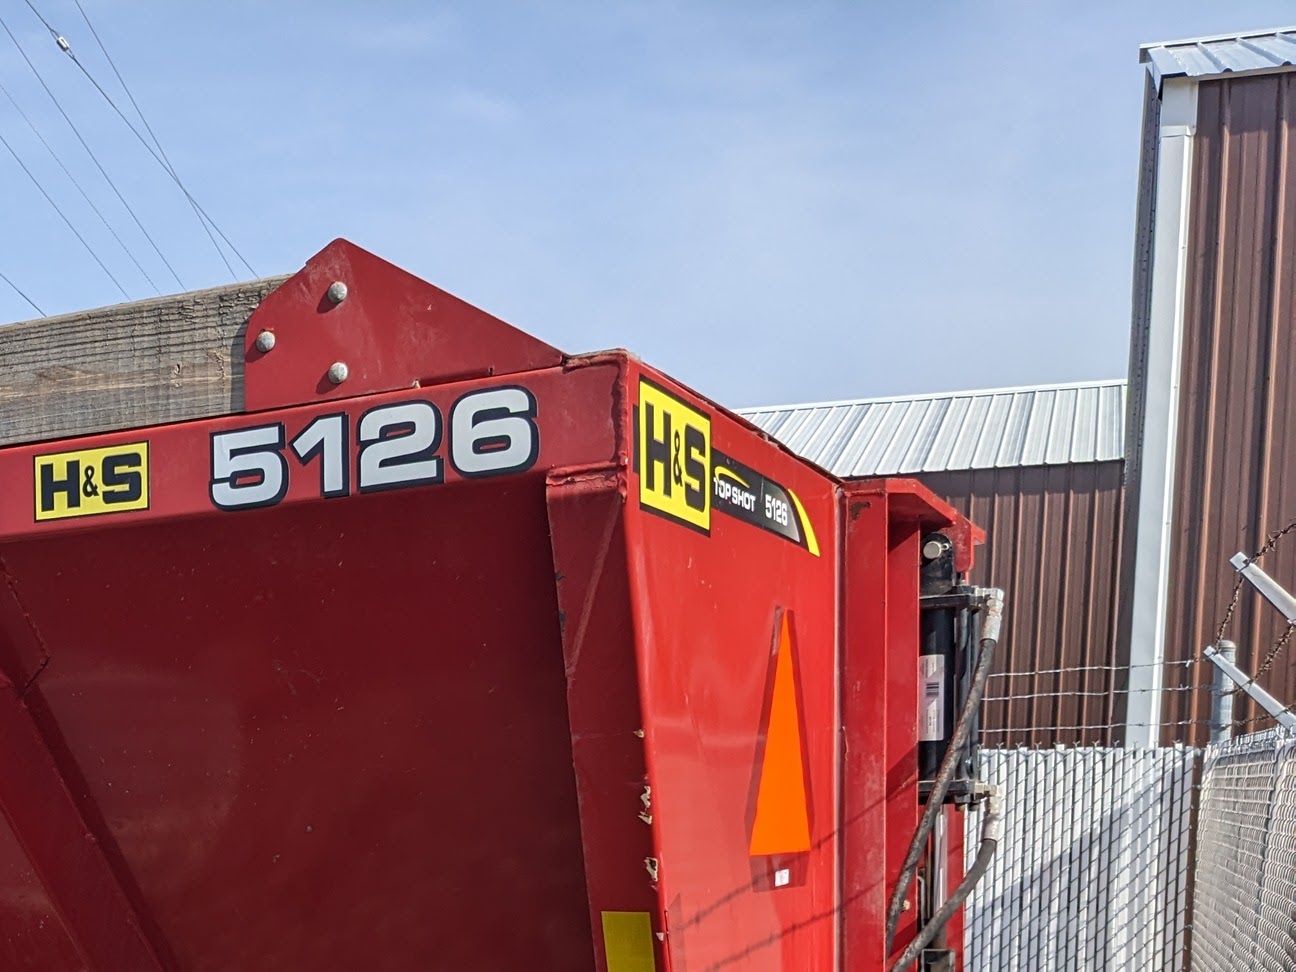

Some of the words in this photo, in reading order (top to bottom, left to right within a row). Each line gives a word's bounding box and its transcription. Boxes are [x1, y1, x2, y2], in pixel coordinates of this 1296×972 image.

[210, 386, 538, 511] 5126
[644, 399, 706, 514] H&S
[39, 452, 143, 512] H&S
[713, 476, 731, 504] TOP
[731, 489, 756, 512] SHOT
[764, 493, 789, 527] 5126
